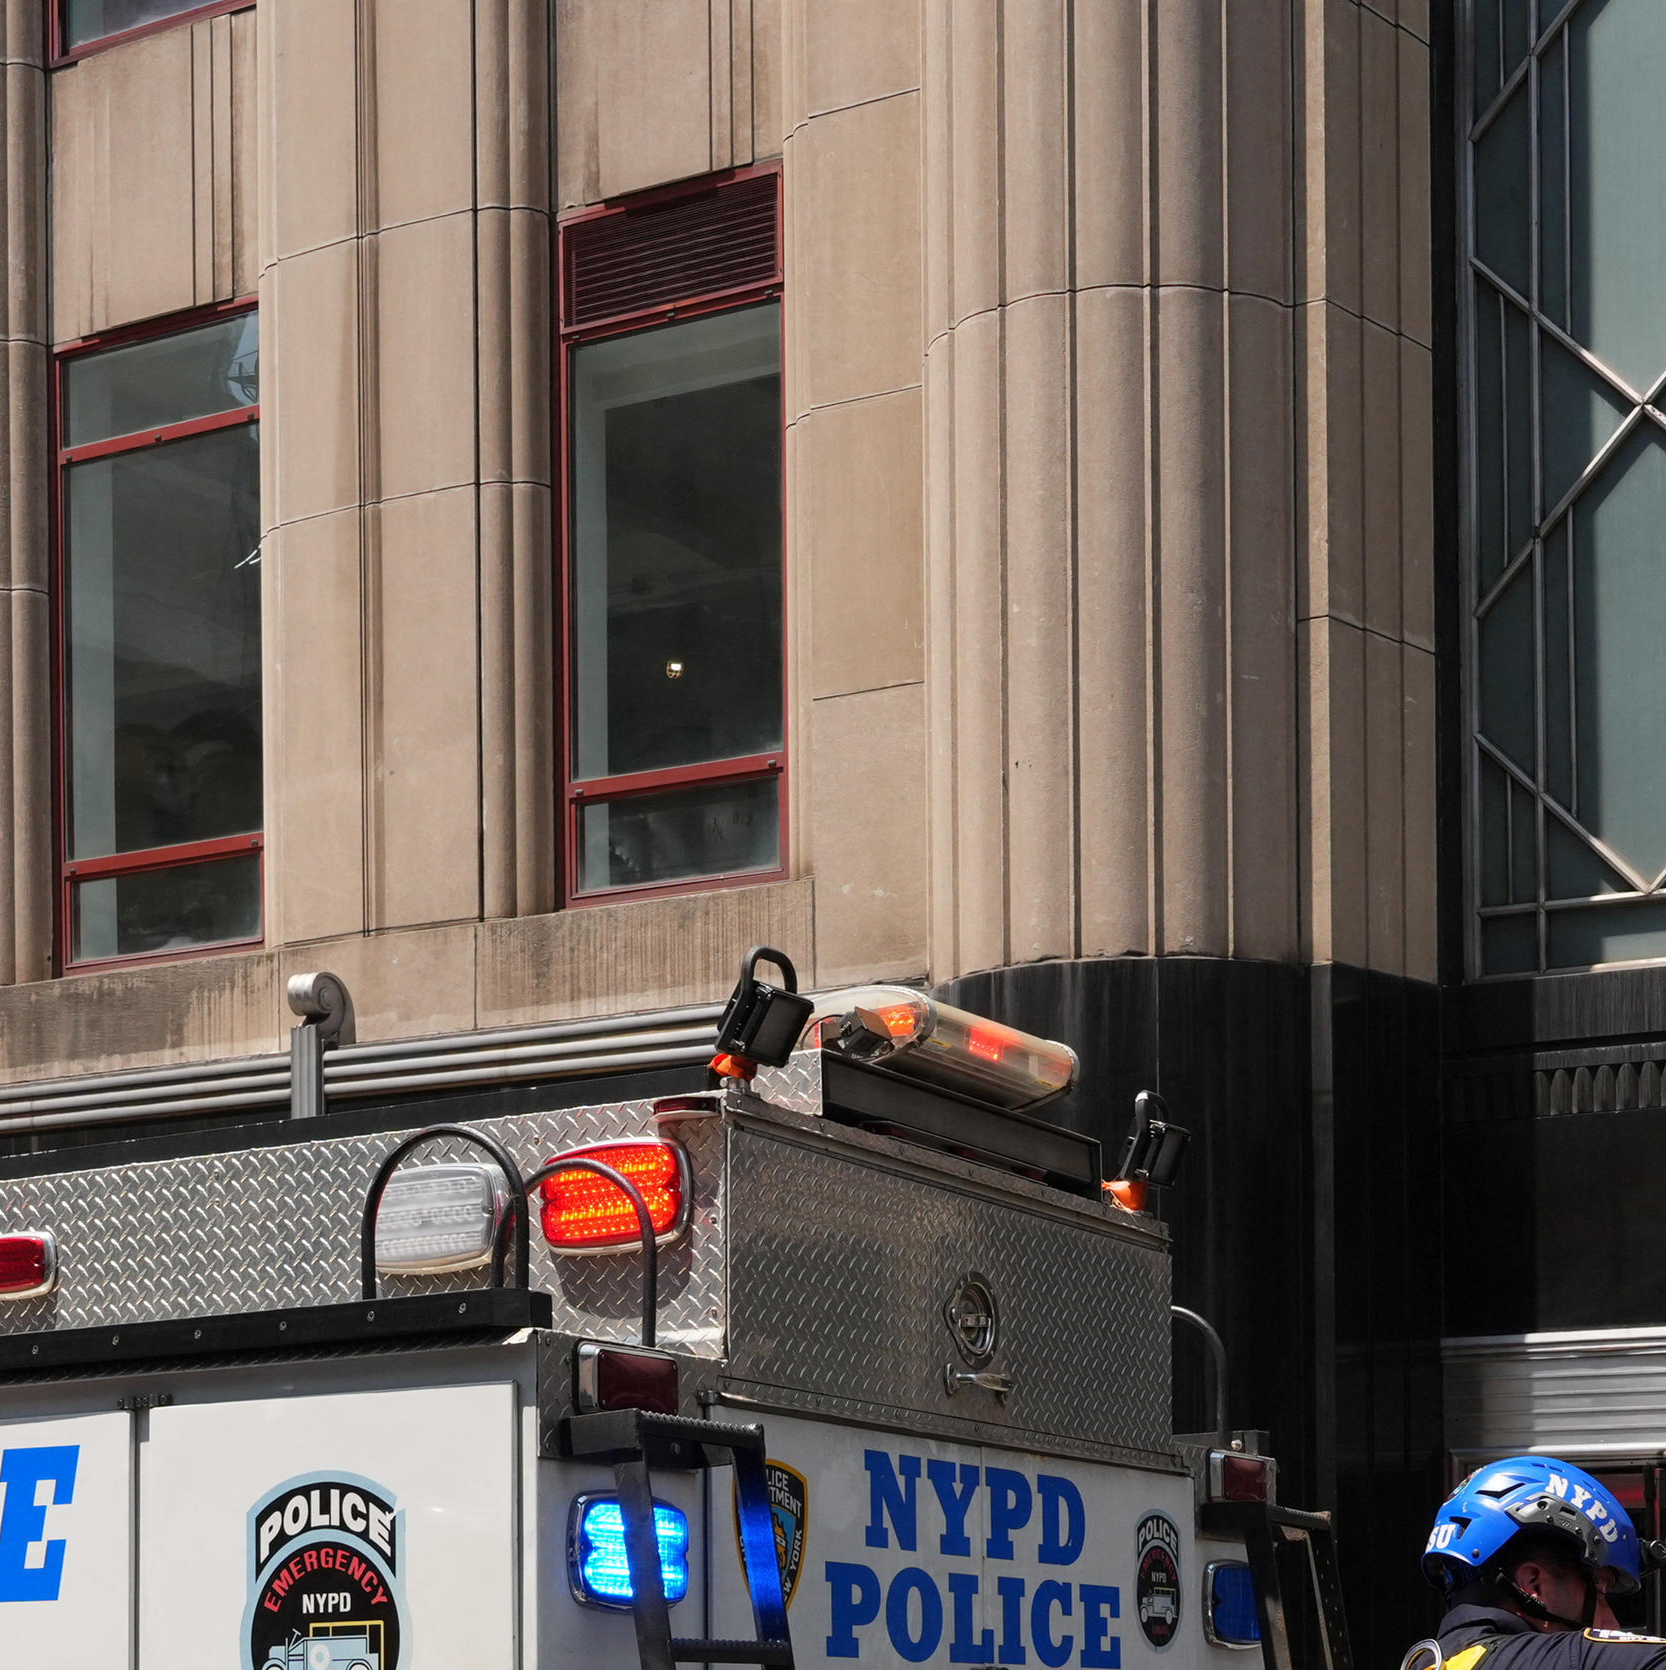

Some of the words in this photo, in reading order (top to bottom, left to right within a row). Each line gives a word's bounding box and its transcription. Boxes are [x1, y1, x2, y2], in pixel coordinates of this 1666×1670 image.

[259, 1488, 391, 1564] POLICE
[864, 1449, 1085, 1566] NYPD
[1138, 1519, 1178, 1557] POLICE
[1425, 1523, 1457, 1552] SU
[1544, 1473, 1620, 1544] NYPD
[263, 1548, 388, 1612] EMERGENCY
[790, 1529, 803, 1571] YORK
[302, 1592, 351, 1614] NYPD
[825, 1561, 1121, 1670] POLICE
